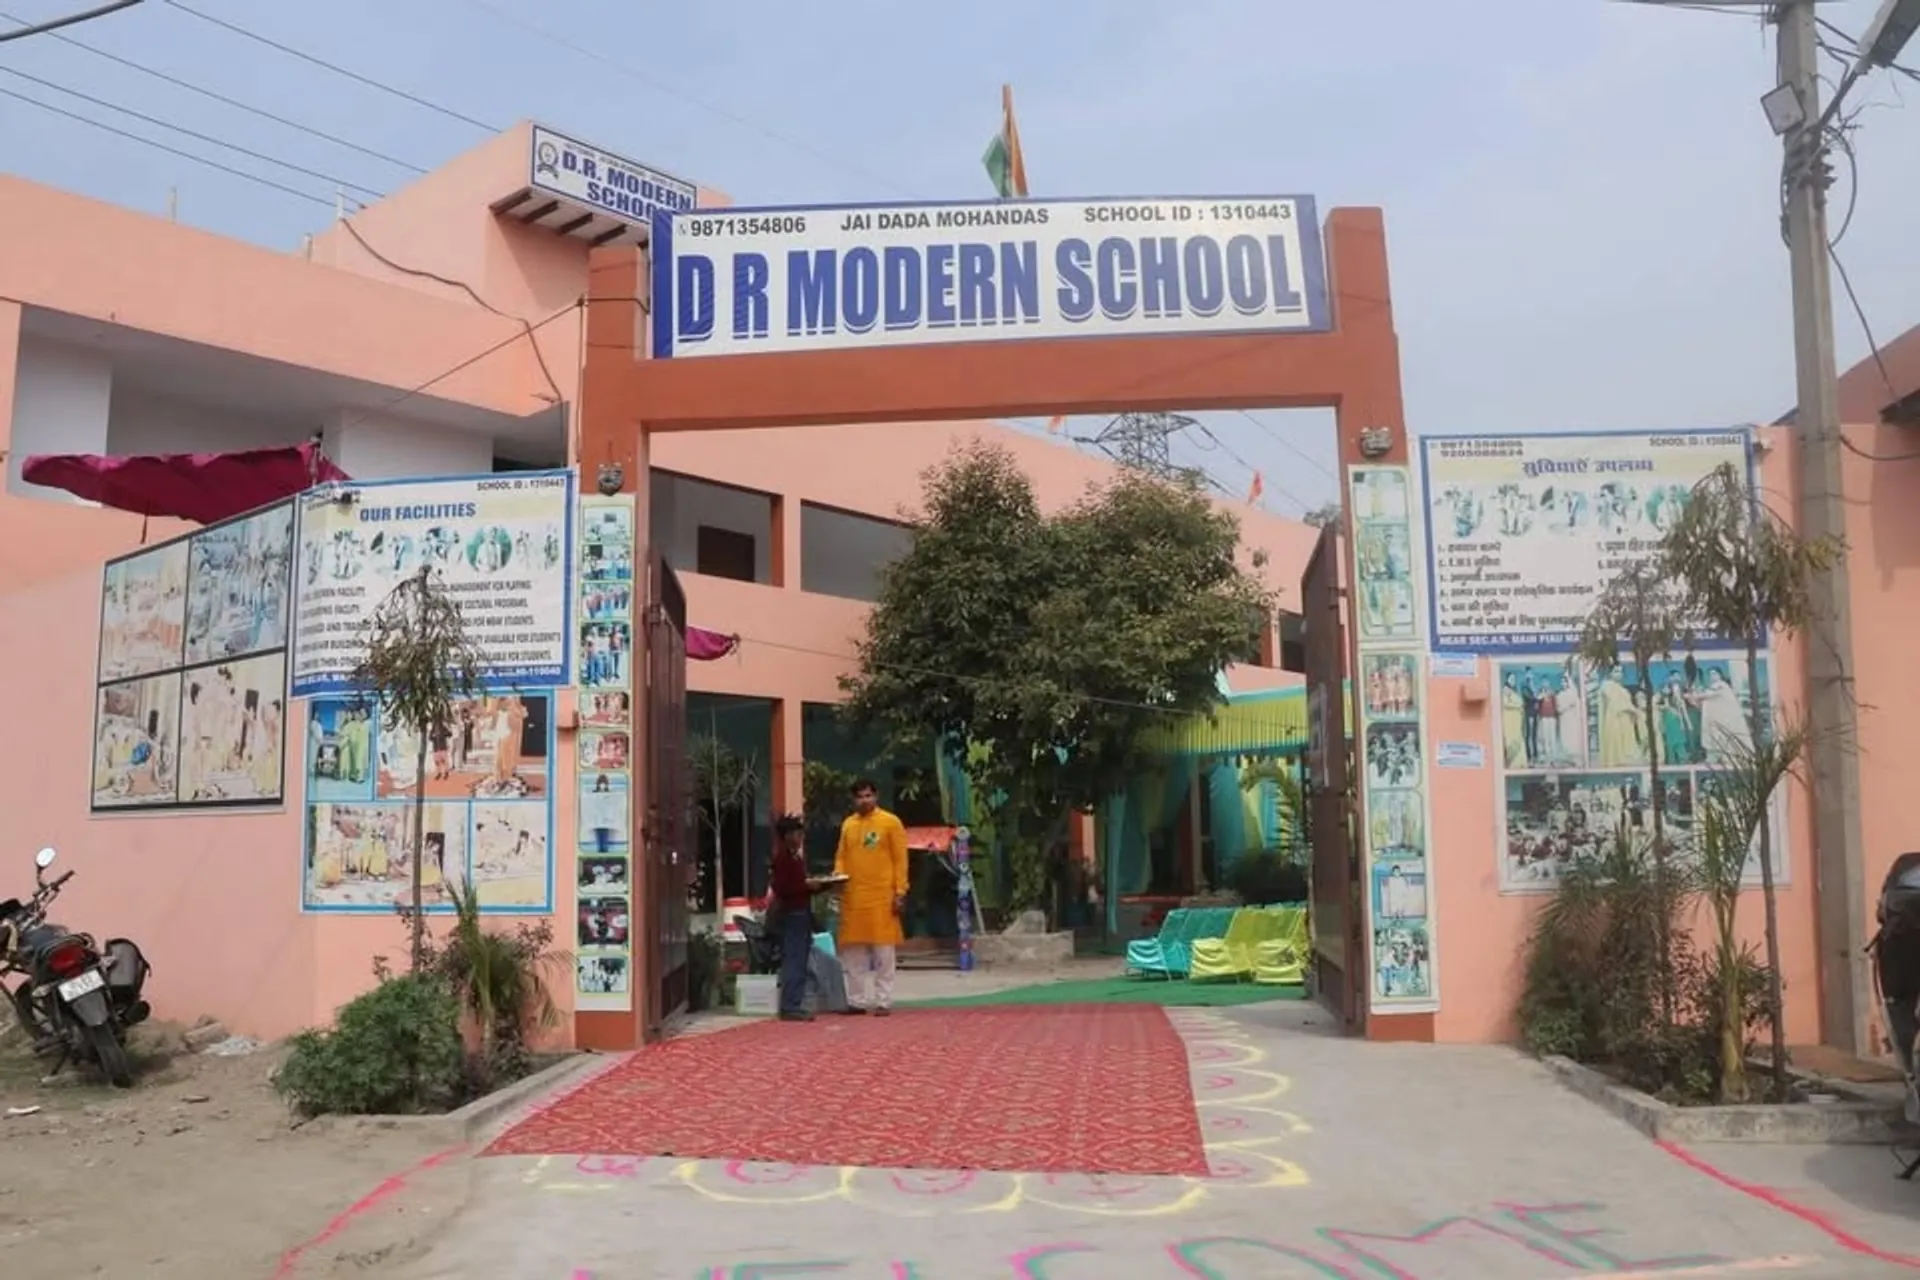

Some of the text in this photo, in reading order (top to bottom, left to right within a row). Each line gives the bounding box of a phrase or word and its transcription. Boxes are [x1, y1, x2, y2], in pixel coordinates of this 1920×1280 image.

[562, 149, 602, 182] D.R.
[607, 166, 692, 211] MODERN
[587, 181, 656, 219] SCHOO
[840, 208, 1049, 231] JAI DADA MOHANDAS
[1084, 206, 1165, 223] SCHOOL
[1172, 206, 1191, 221] ID
[1210, 204, 1291, 221] 1310443
[690, 216, 806, 236] 9871354806
[677, 233, 1302, 343] D R MODERN SCHOOL
[476, 480, 512, 491] SCHOOL
[360, 502, 476, 522] OUR FACILITIES
